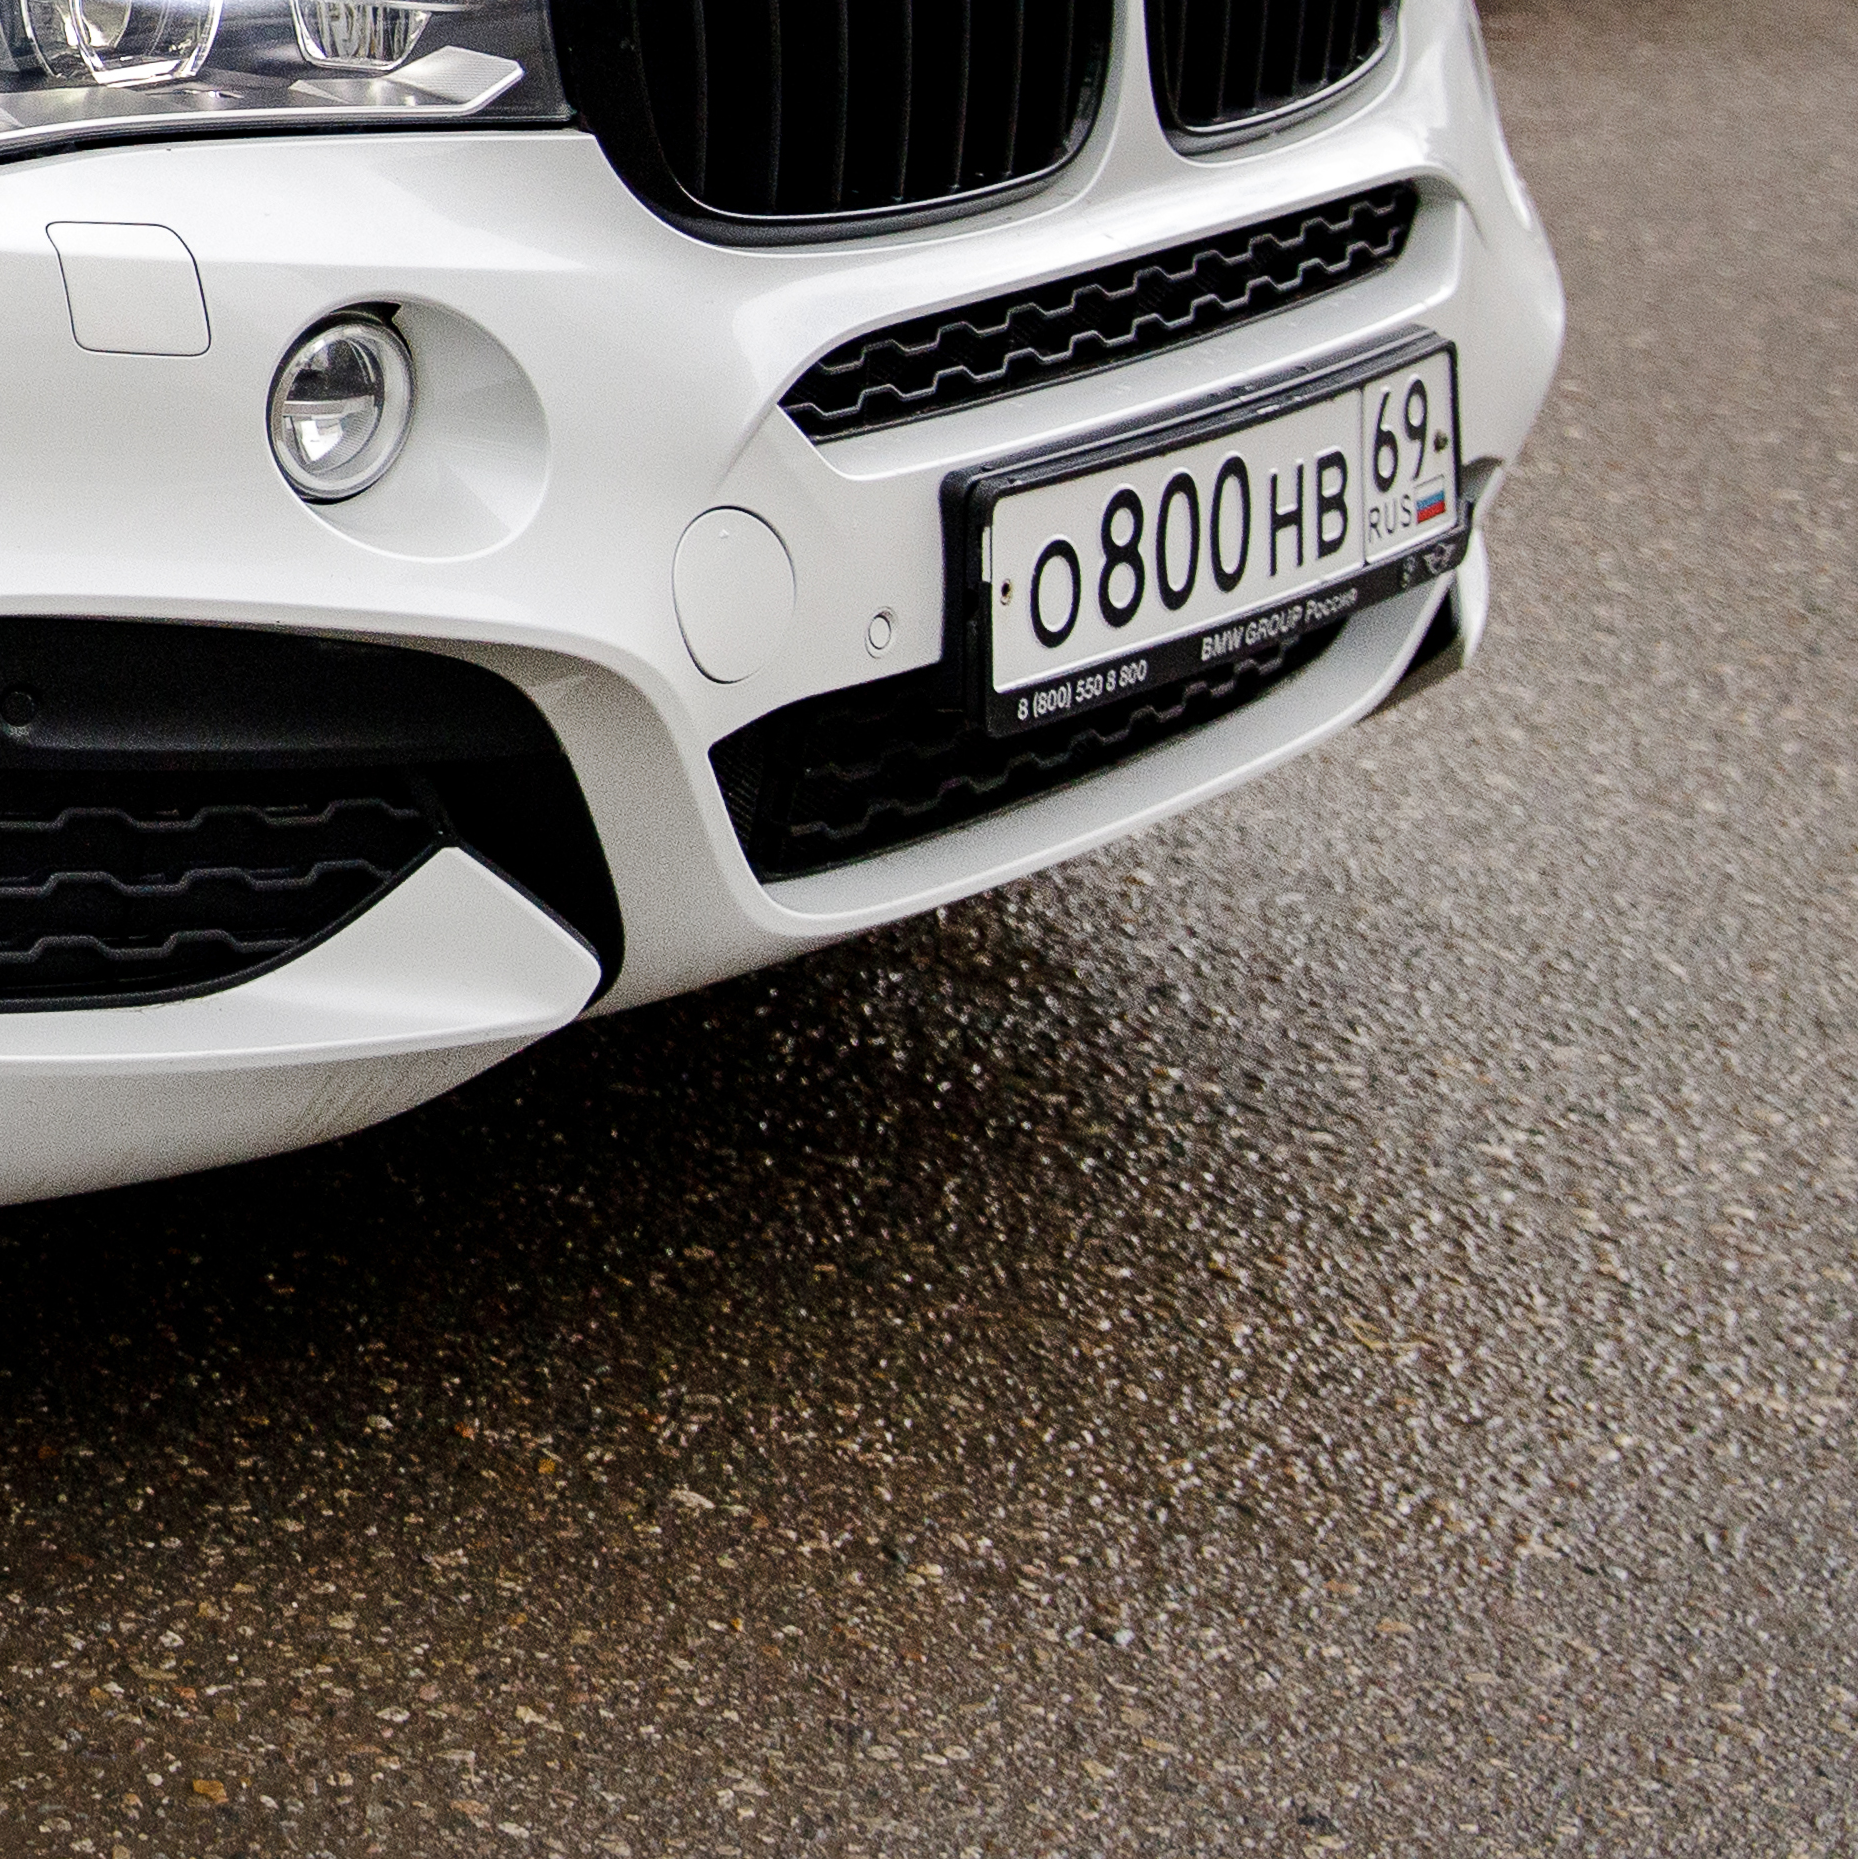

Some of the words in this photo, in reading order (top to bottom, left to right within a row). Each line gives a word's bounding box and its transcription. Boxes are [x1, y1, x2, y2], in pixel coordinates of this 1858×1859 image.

[1371, 375, 1430, 492] 69
[1367, 494, 1413, 543] RUS
[1200, 626, 1245, 661] BMW
[1245, 605, 1304, 644] GROUP
[1017, 698, 1029, 720] 8
[1033, 683, 1072, 718] (800)
[1075, 674, 1103, 703] 550
[1106, 669, 1116, 691] 8
[1119, 659, 1148, 687] 800
